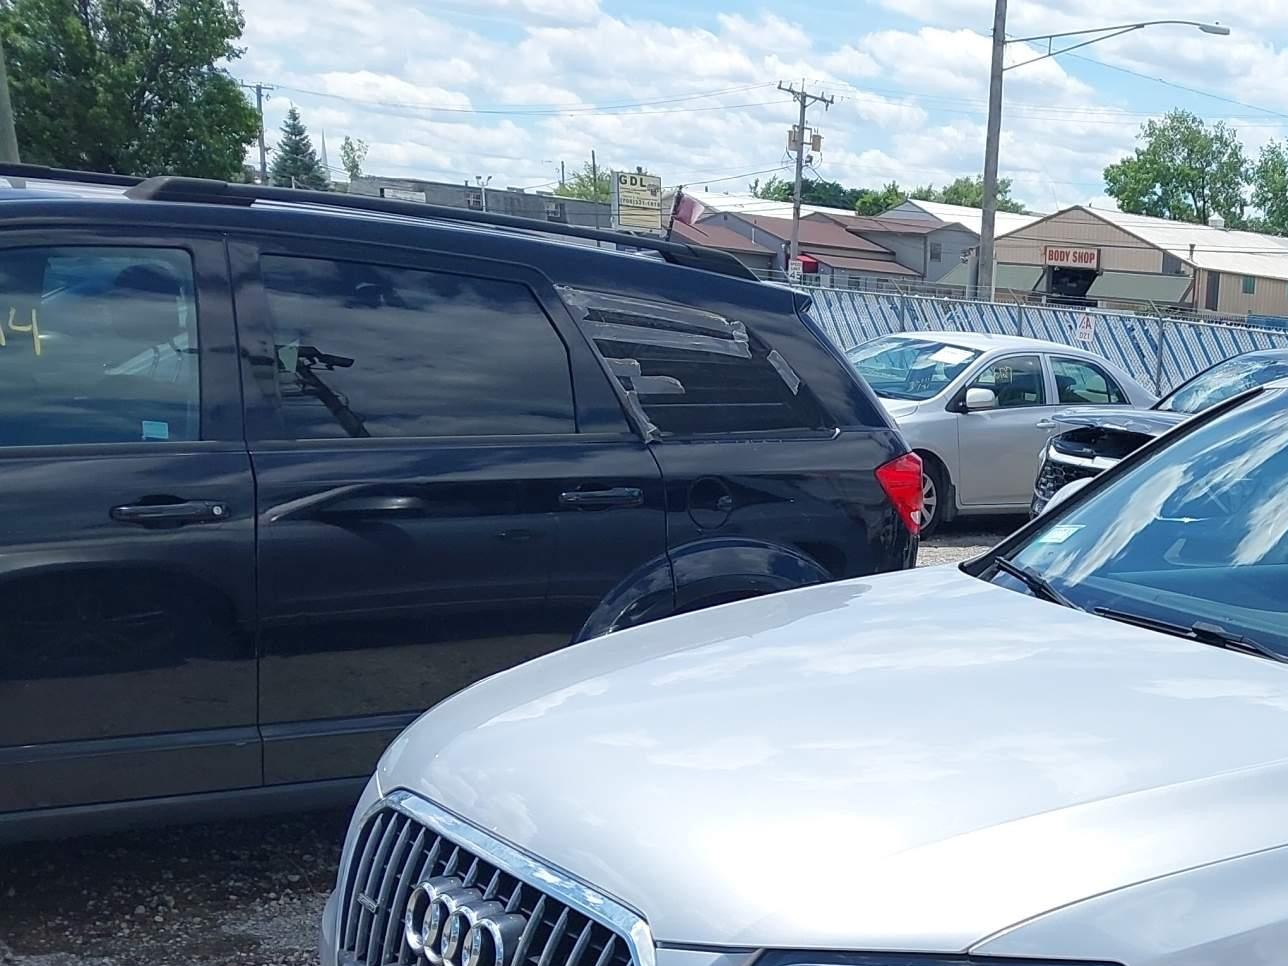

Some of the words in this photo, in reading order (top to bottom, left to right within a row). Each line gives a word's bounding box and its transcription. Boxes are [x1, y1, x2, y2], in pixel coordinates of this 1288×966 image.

[619, 174, 647, 188] GDL
[1048, 249, 1071, 262] BODY
[1072, 250, 1095, 264] SHOP
